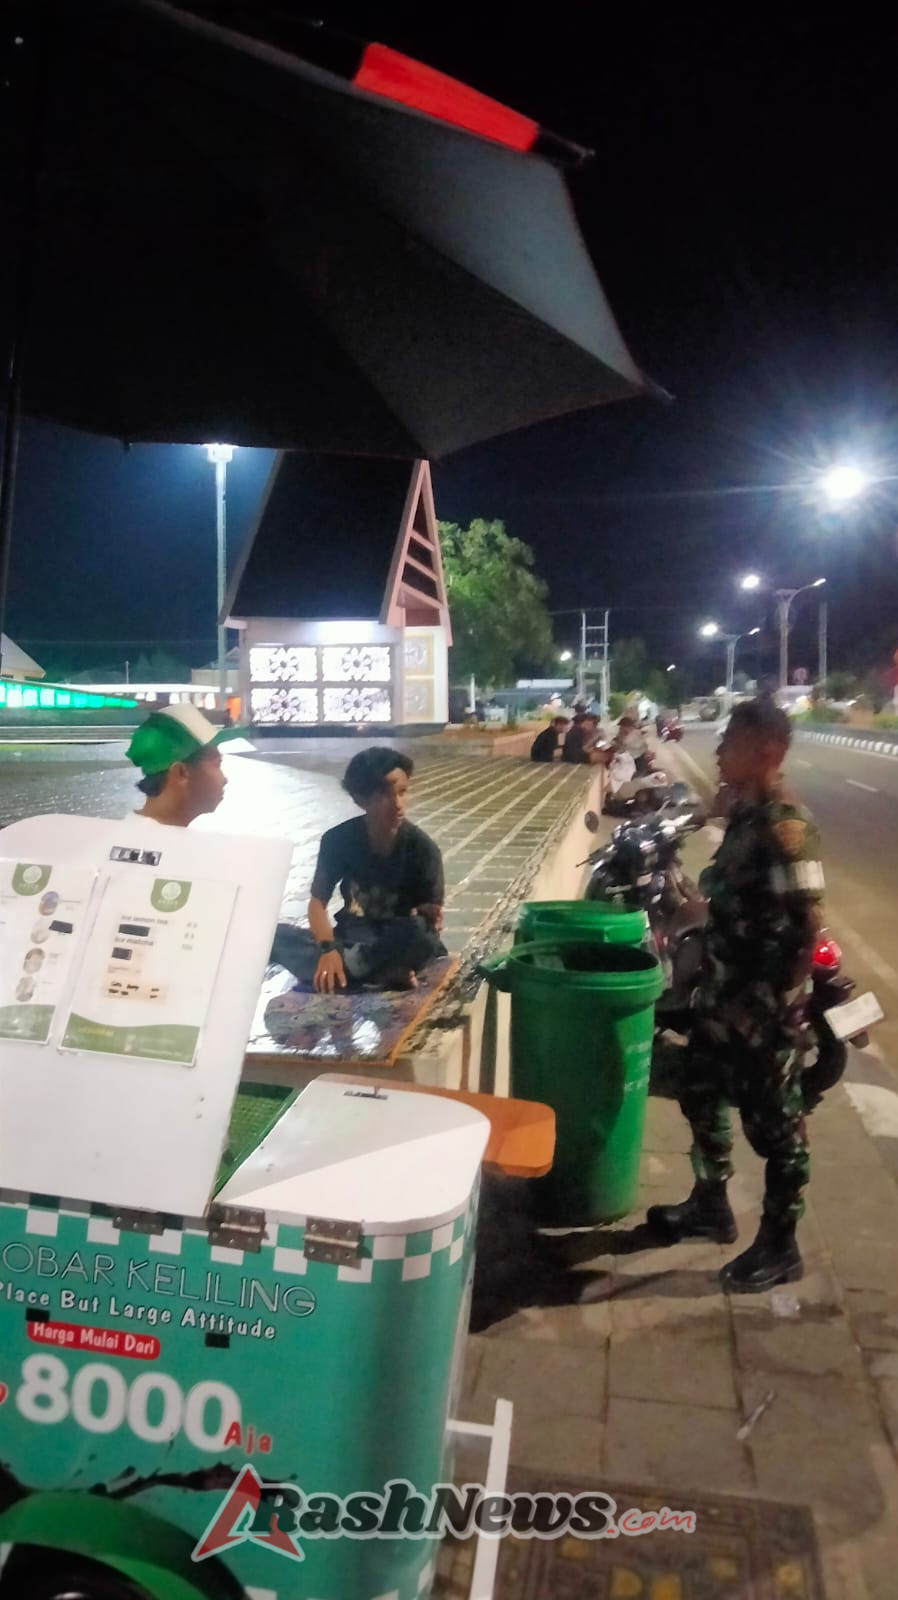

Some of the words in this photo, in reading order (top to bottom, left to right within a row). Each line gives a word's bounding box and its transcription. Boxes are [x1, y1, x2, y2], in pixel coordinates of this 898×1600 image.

[61, 1290, 99, 1312] But
[109, 1297, 171, 1326] Large
[181, 1308, 276, 1339] Attitude
[128, 1259, 317, 1317] KELILING
[33, 1321, 75, 1345] Harga
[80, 1328, 119, 1349] Mulai
[124, 1333, 155, 1354] Dari
[15, 1352, 243, 1453] 8000
[223, 1421, 273, 1456] Aja
